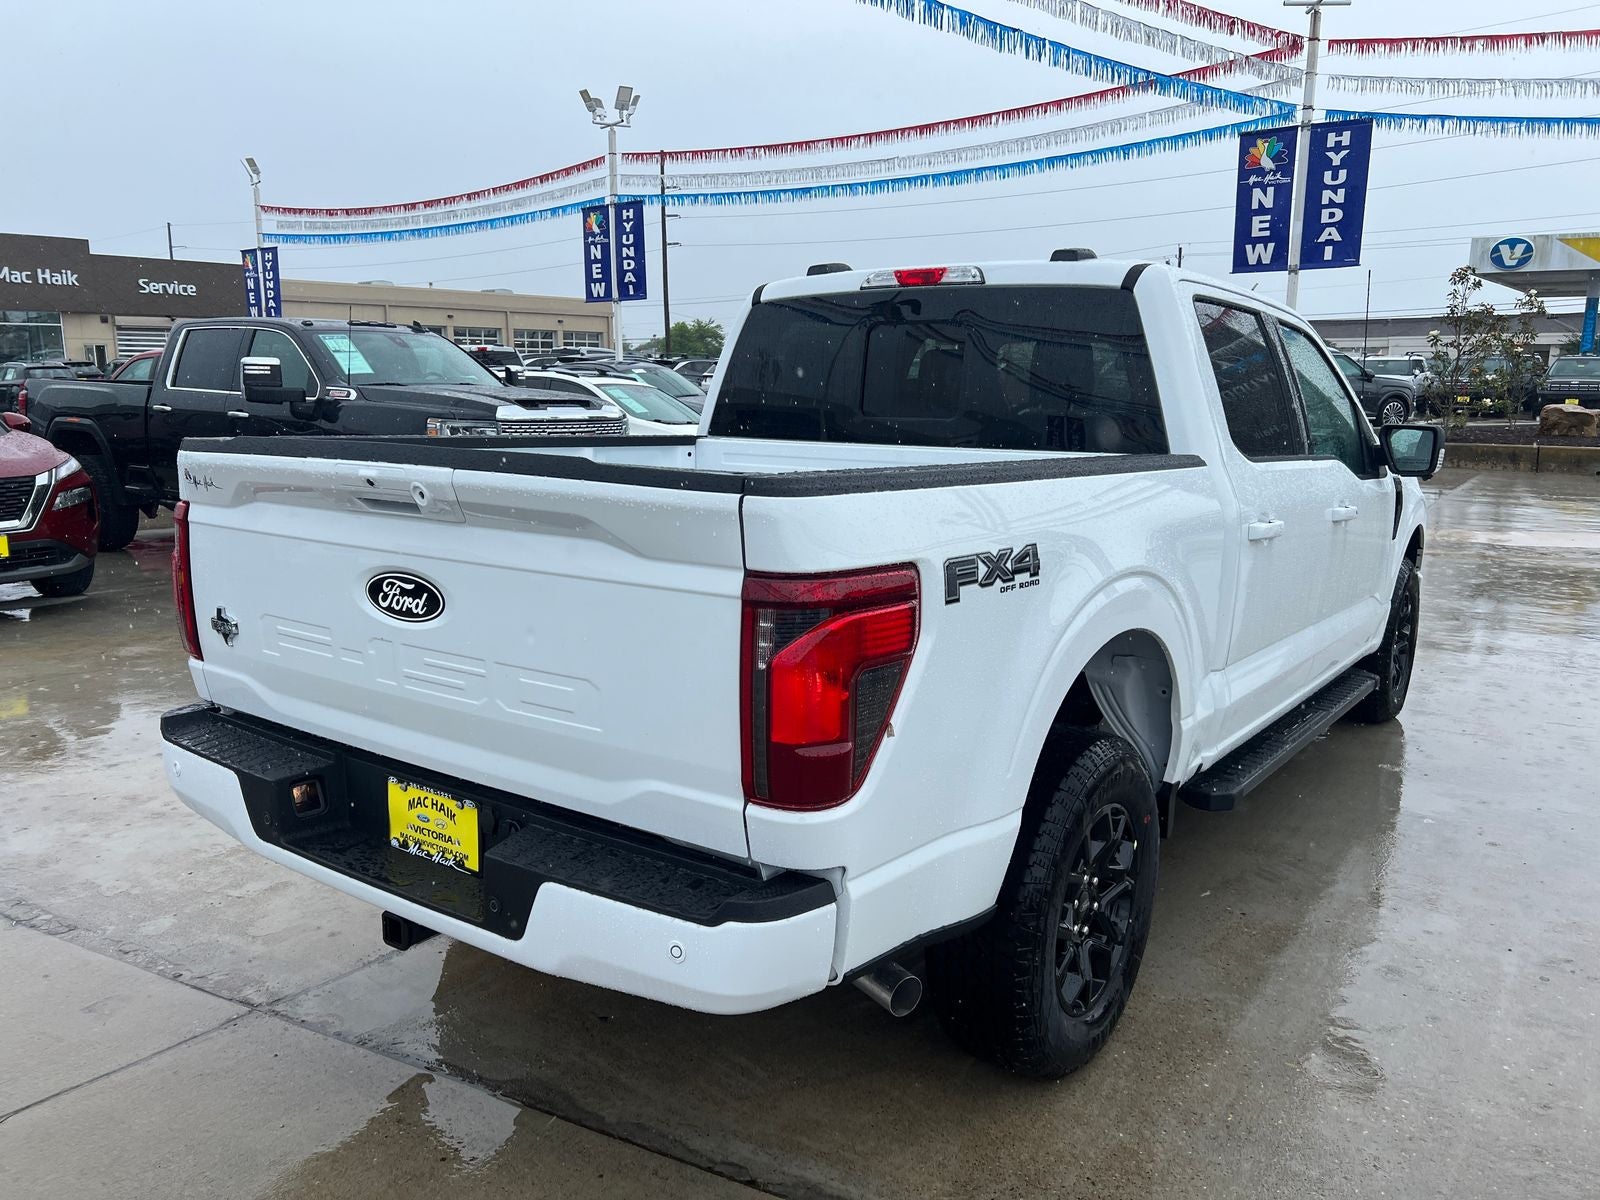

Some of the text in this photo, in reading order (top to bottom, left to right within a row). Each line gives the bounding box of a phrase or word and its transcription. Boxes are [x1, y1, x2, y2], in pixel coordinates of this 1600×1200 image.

[1317, 131, 1351, 260] HYUNDAI
[1245, 186, 1275, 265] NEW
[624, 209, 636, 294] HYUNDAI
[0, 266, 80, 287] Mac Haik
[138, 278, 197, 296] Service
[265, 252, 276, 317] HYUNDAI
[591, 244, 605, 297] NEW
[247, 278, 258, 317] NEW
[943, 542, 1040, 606] FX4
[1000, 579, 1040, 593] OFF ROAD
[378, 578, 427, 614] Ford
[408, 796, 428, 810] MAC
[431, 799, 456, 824] HAIK
[412, 824, 453, 846] VICTORIA
[407, 843, 464, 870] Mac Haik
